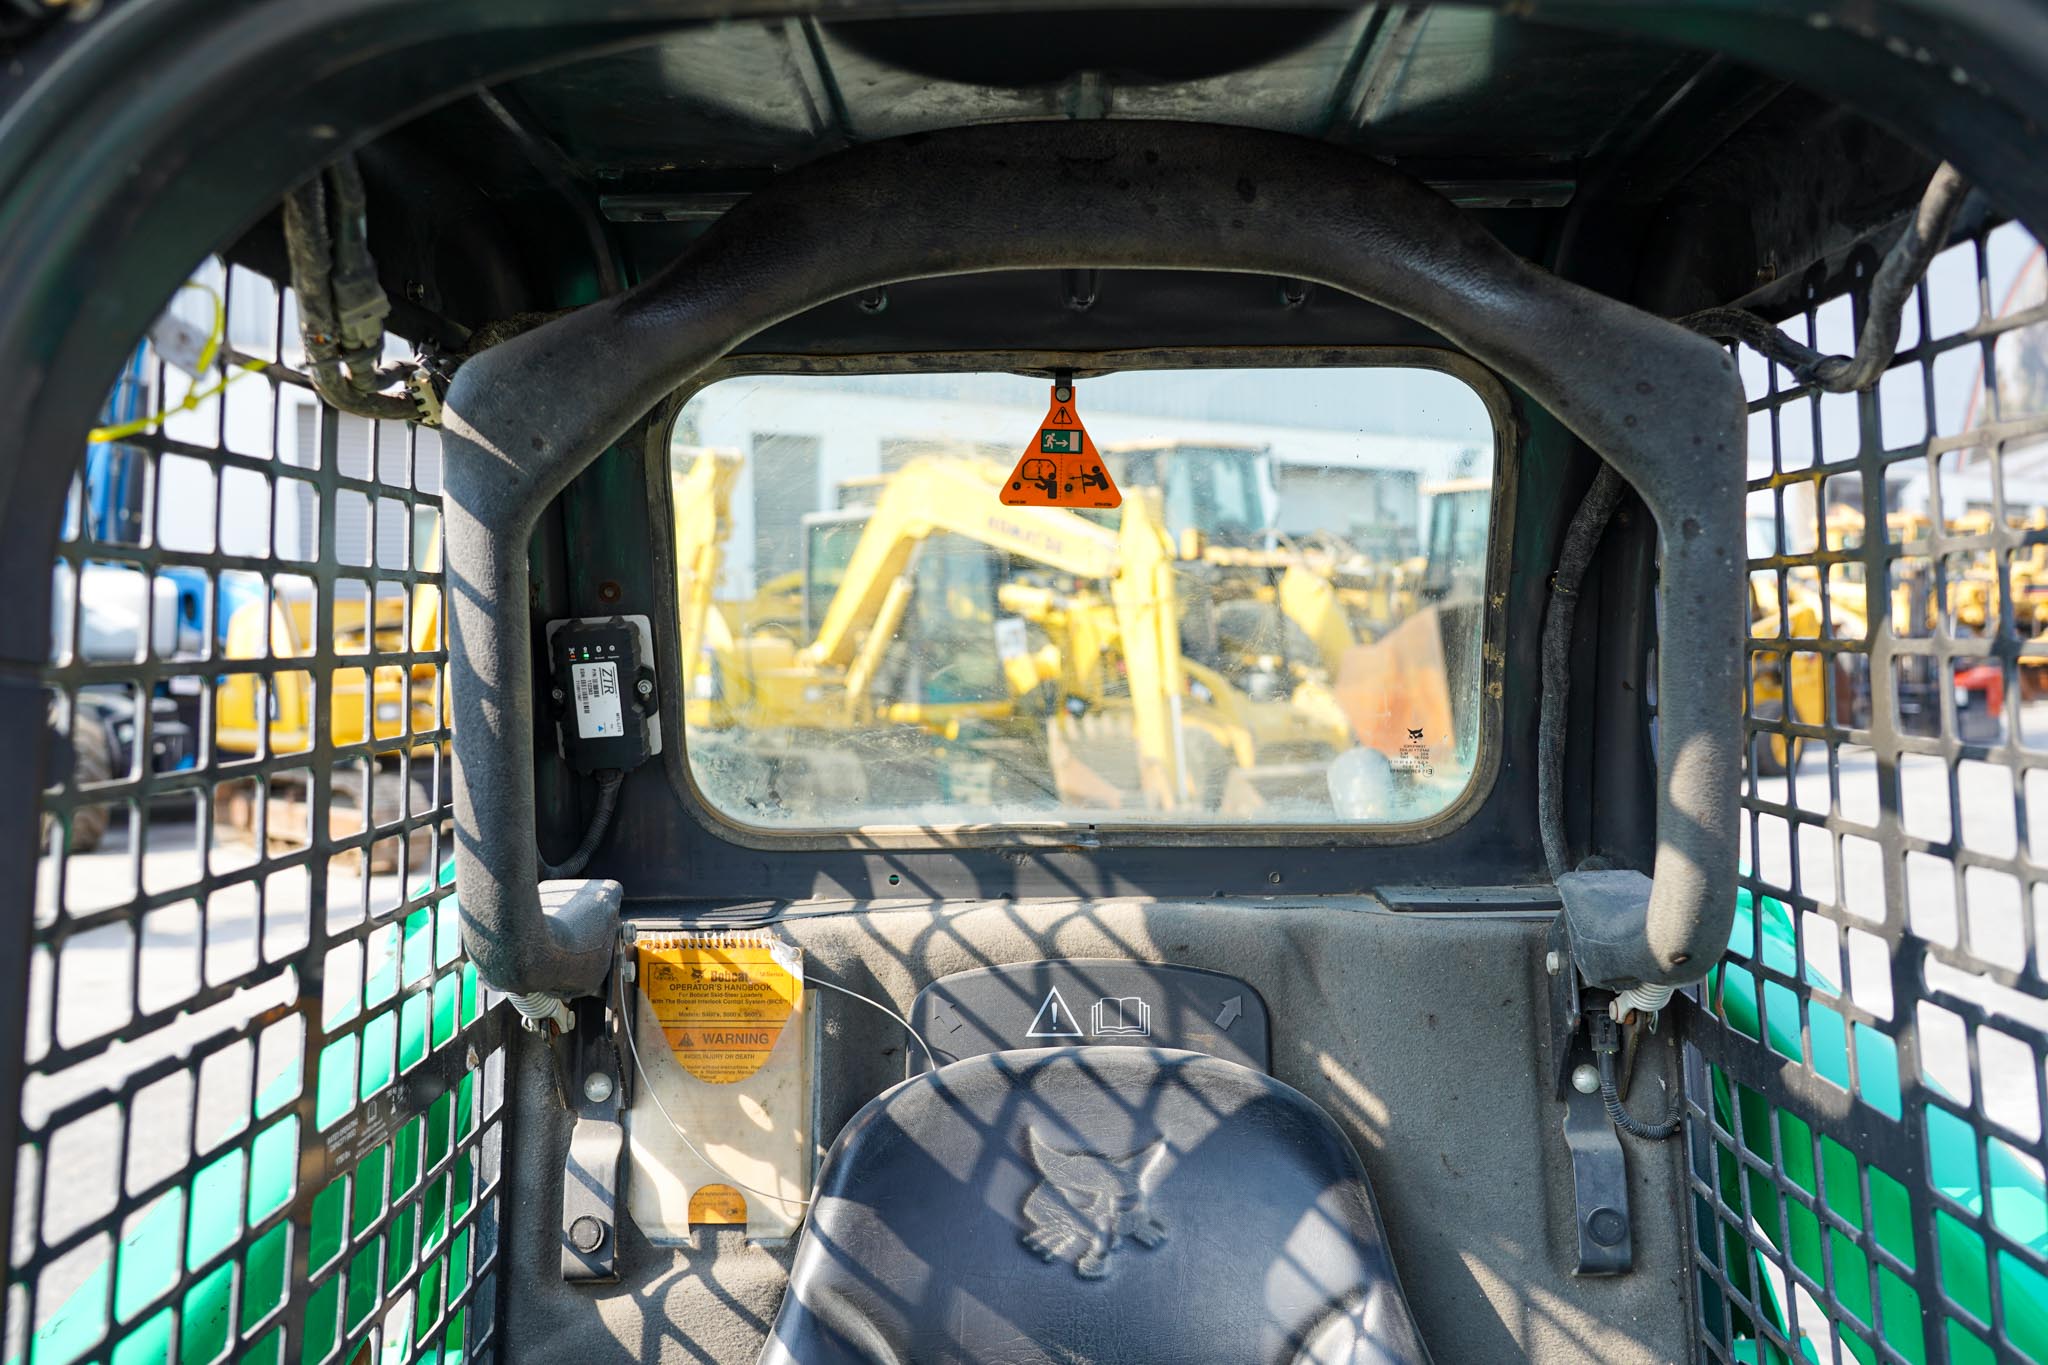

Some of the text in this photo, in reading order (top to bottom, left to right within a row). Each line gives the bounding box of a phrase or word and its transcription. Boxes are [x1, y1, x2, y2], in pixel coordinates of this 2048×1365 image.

[602, 668, 615, 695] ZTR
[710, 970, 749, 983] Bobcat
[669, 983, 773, 991] OPERATOR'S HANDBOOK
[702, 1033, 769, 1044] WARNING
